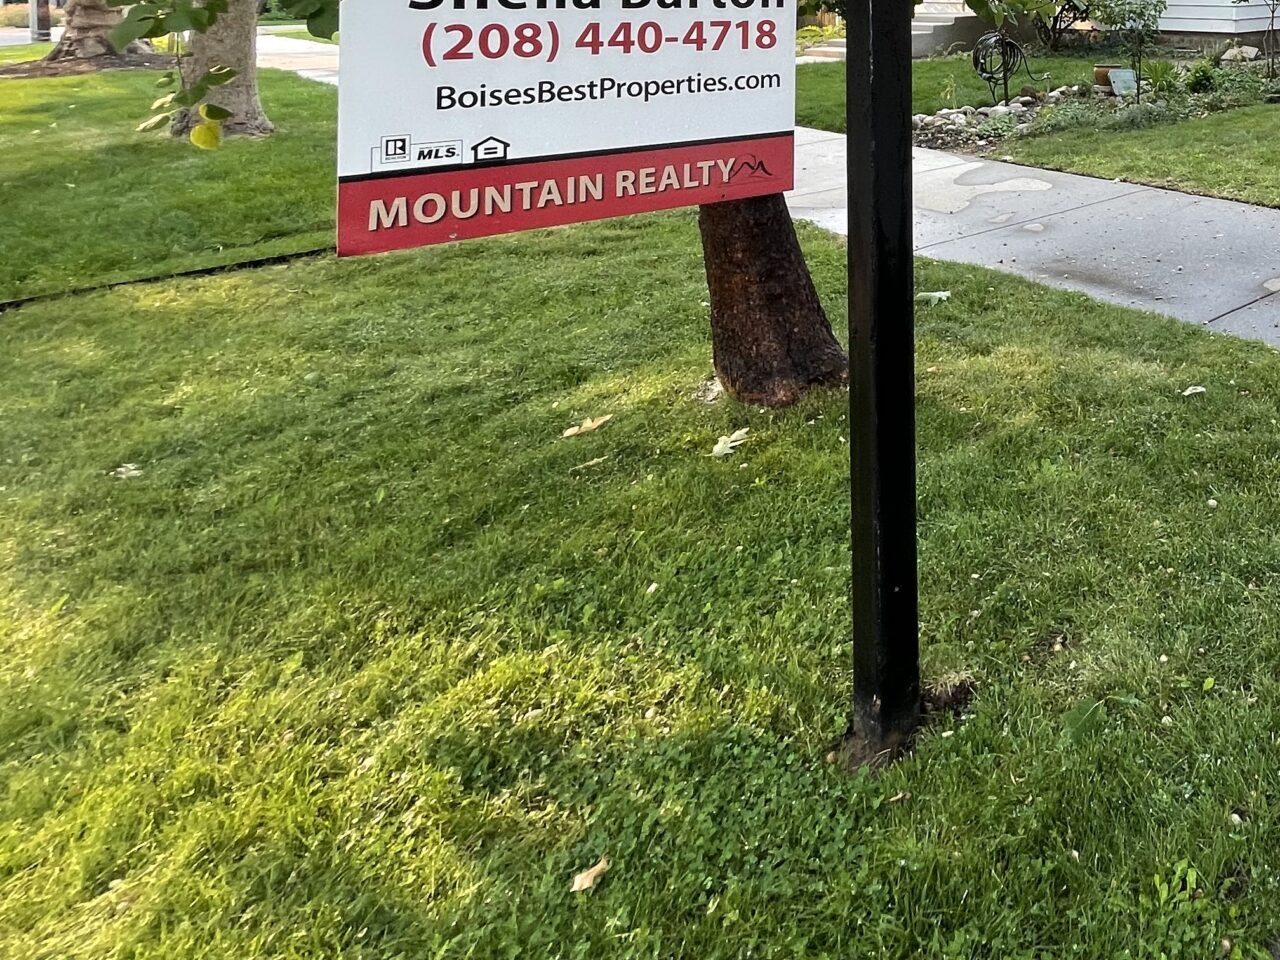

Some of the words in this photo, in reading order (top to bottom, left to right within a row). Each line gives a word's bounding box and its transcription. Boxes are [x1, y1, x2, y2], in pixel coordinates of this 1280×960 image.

[422, 20, 560, 67] (208)
[575, 19, 777, 55] 440-4718
[436, 73, 781, 110] BoisesBestProperties.com
[367, 173, 604, 232] MOUNTAIN
[615, 157, 736, 198] REALTY
